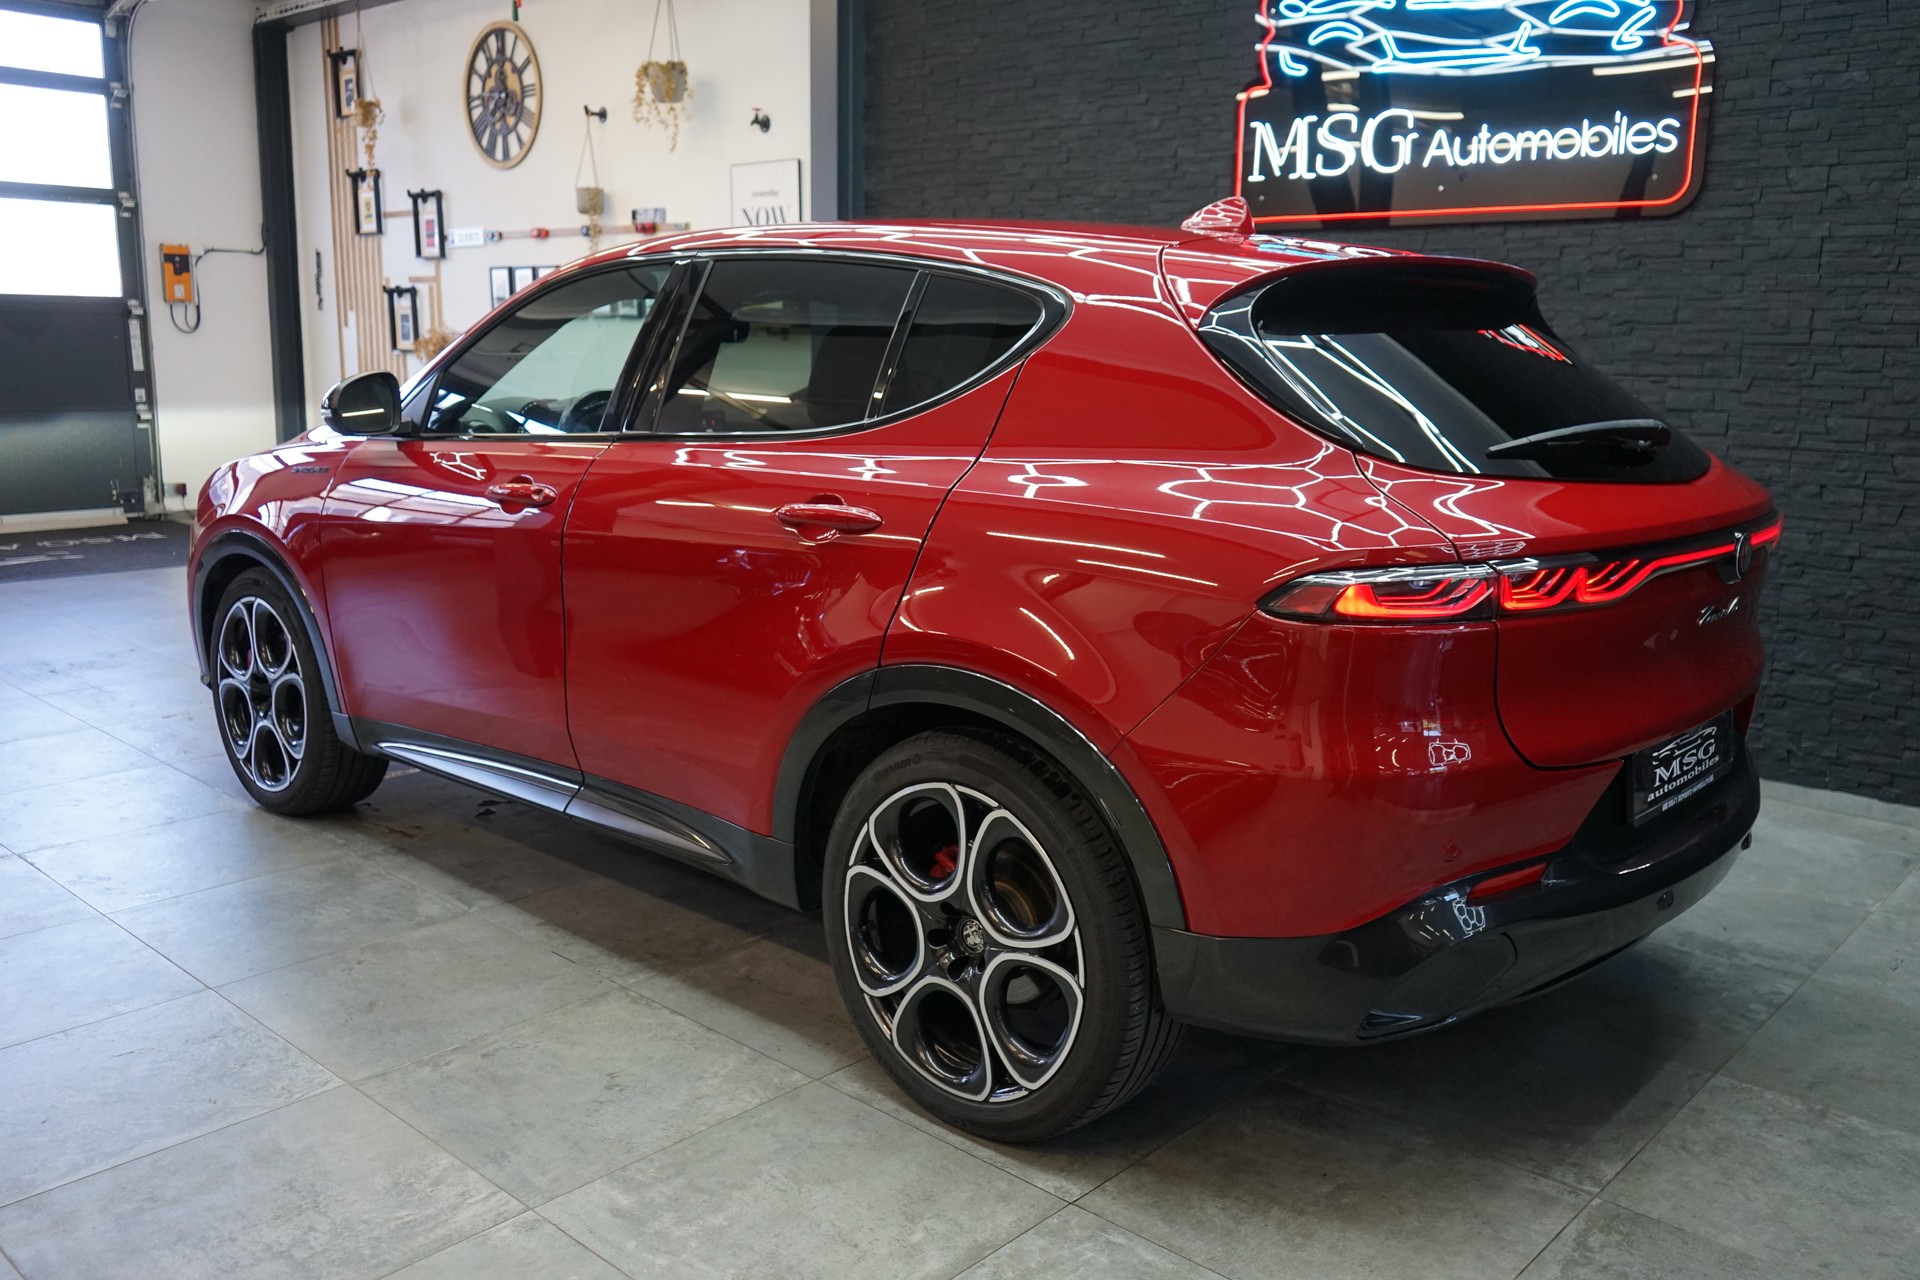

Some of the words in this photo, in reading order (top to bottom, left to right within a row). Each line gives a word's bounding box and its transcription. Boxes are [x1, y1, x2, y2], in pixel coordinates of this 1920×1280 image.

[1247, 107, 1420, 182] MSG
[1421, 110, 1682, 168] Automobiles
[1647, 754, 1720, 802] automobiles
[1653, 739, 1716, 788] MSG
